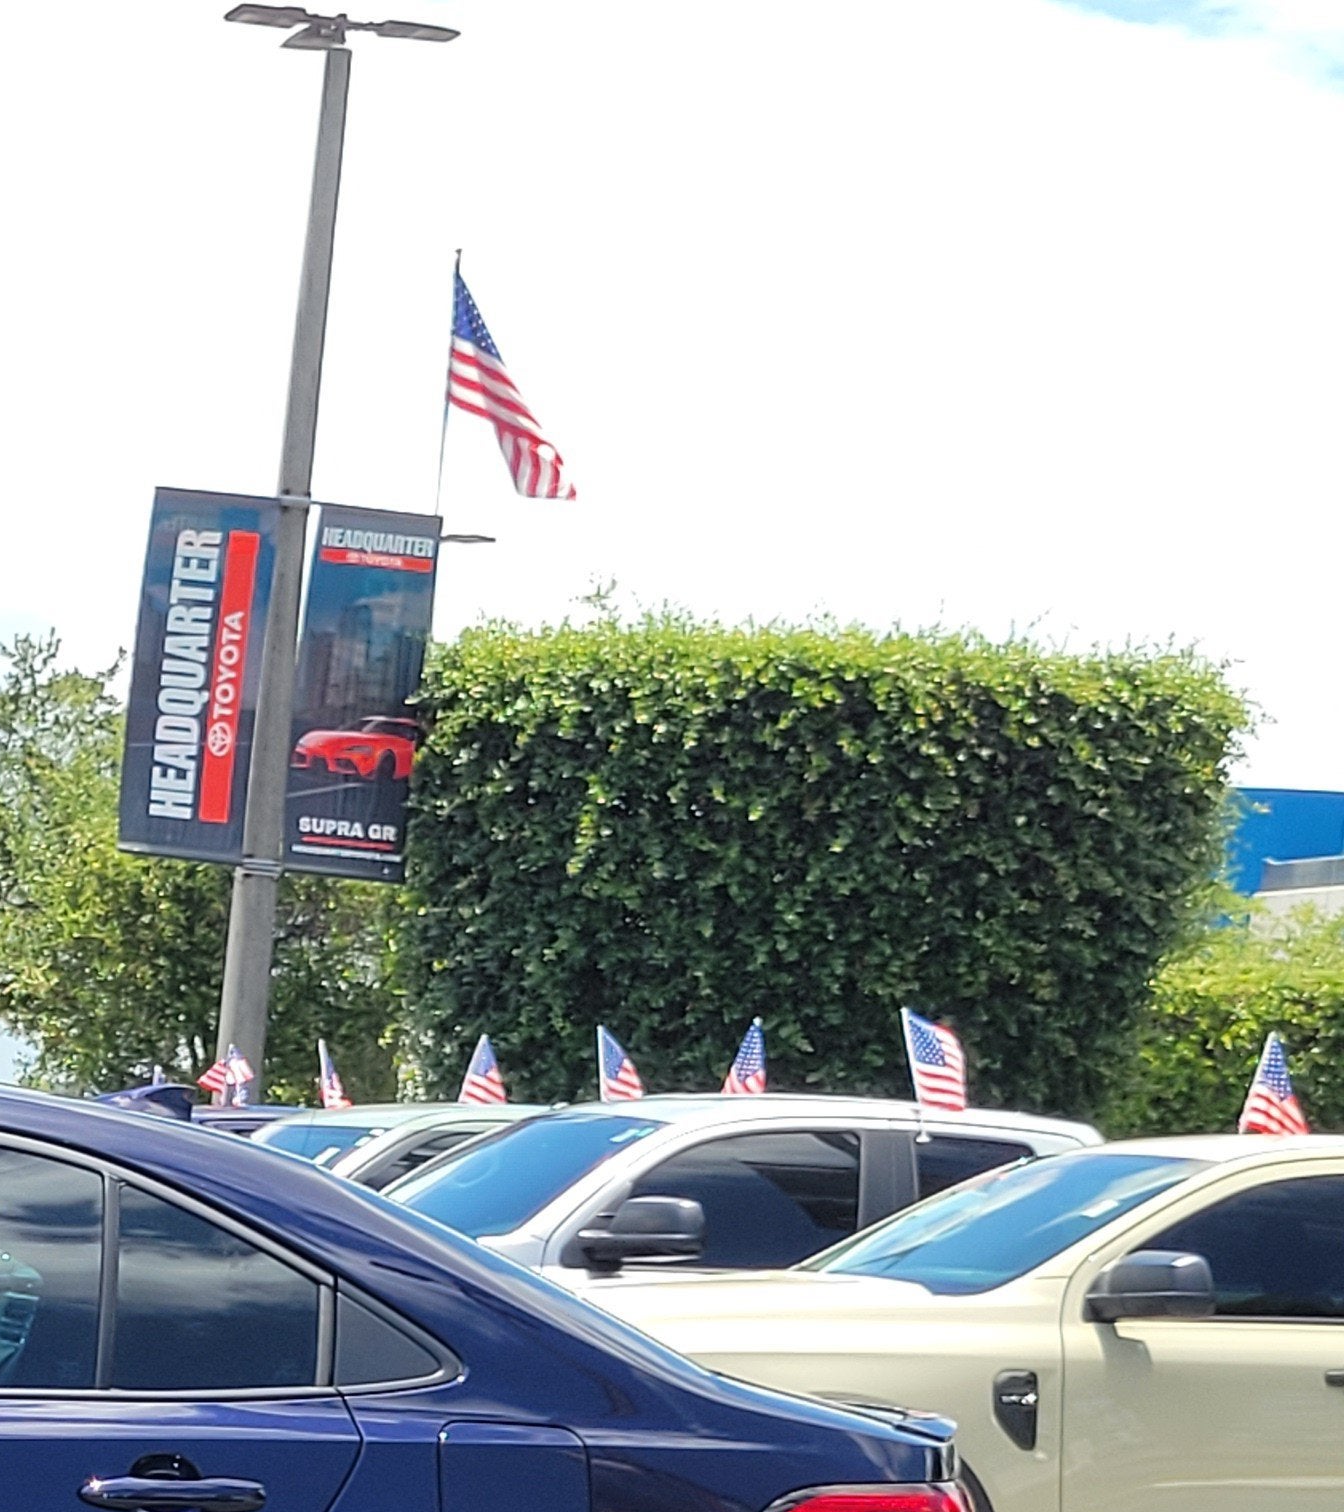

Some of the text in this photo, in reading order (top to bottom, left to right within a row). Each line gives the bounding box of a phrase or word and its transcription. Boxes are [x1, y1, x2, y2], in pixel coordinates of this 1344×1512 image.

[321, 526, 433, 558] HEADQUARTER
[148, 529, 224, 820] HEADQUARTER
[213, 611, 246, 719] TOYOTA
[298, 816, 398, 842] SUPRA GR
